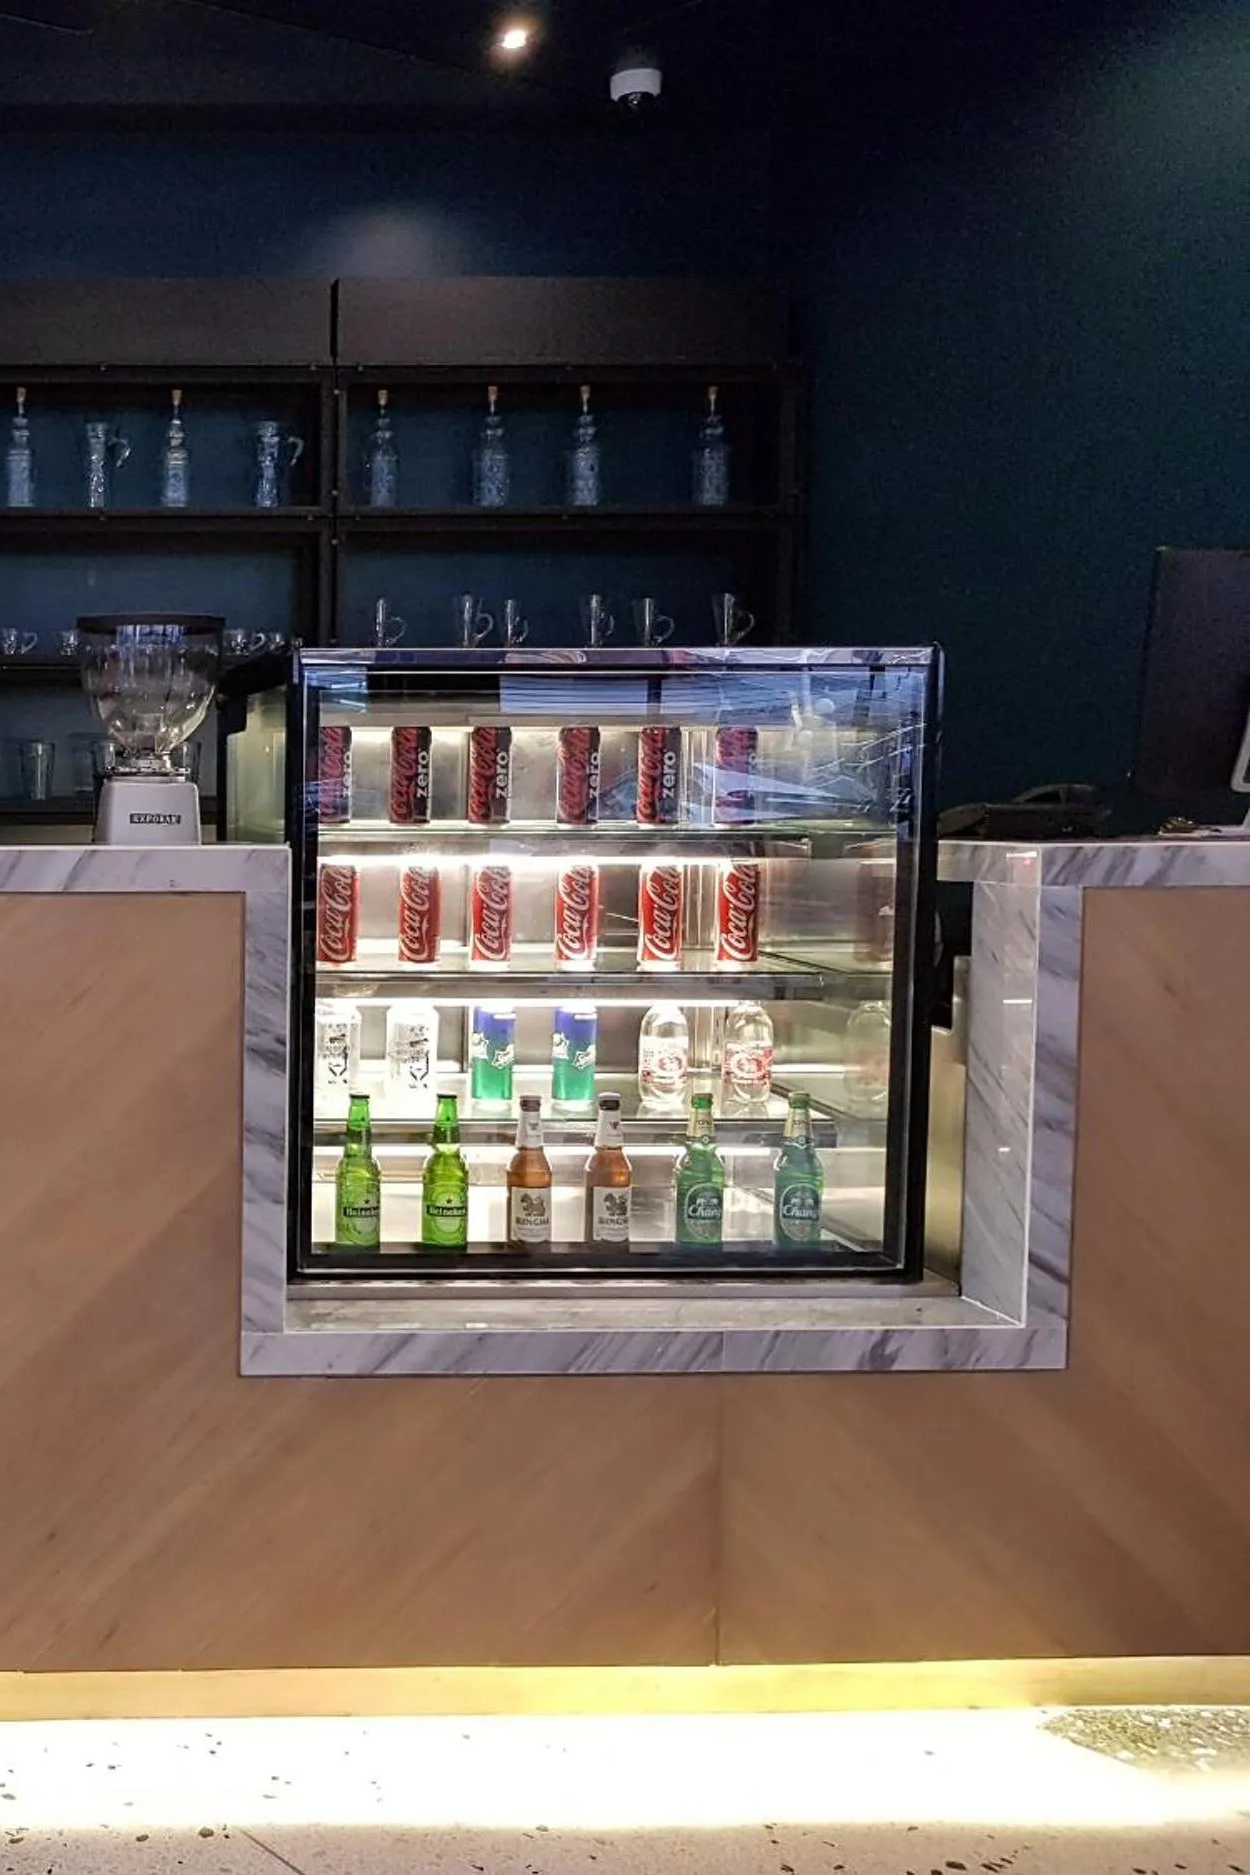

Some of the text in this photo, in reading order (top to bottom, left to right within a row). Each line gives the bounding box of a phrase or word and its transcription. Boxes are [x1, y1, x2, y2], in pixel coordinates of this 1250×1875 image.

[416, 750, 431, 798] zero
[495, 750, 510, 799] zero
[588, 750, 600, 799] zero
[662, 750, 677, 799] zero
